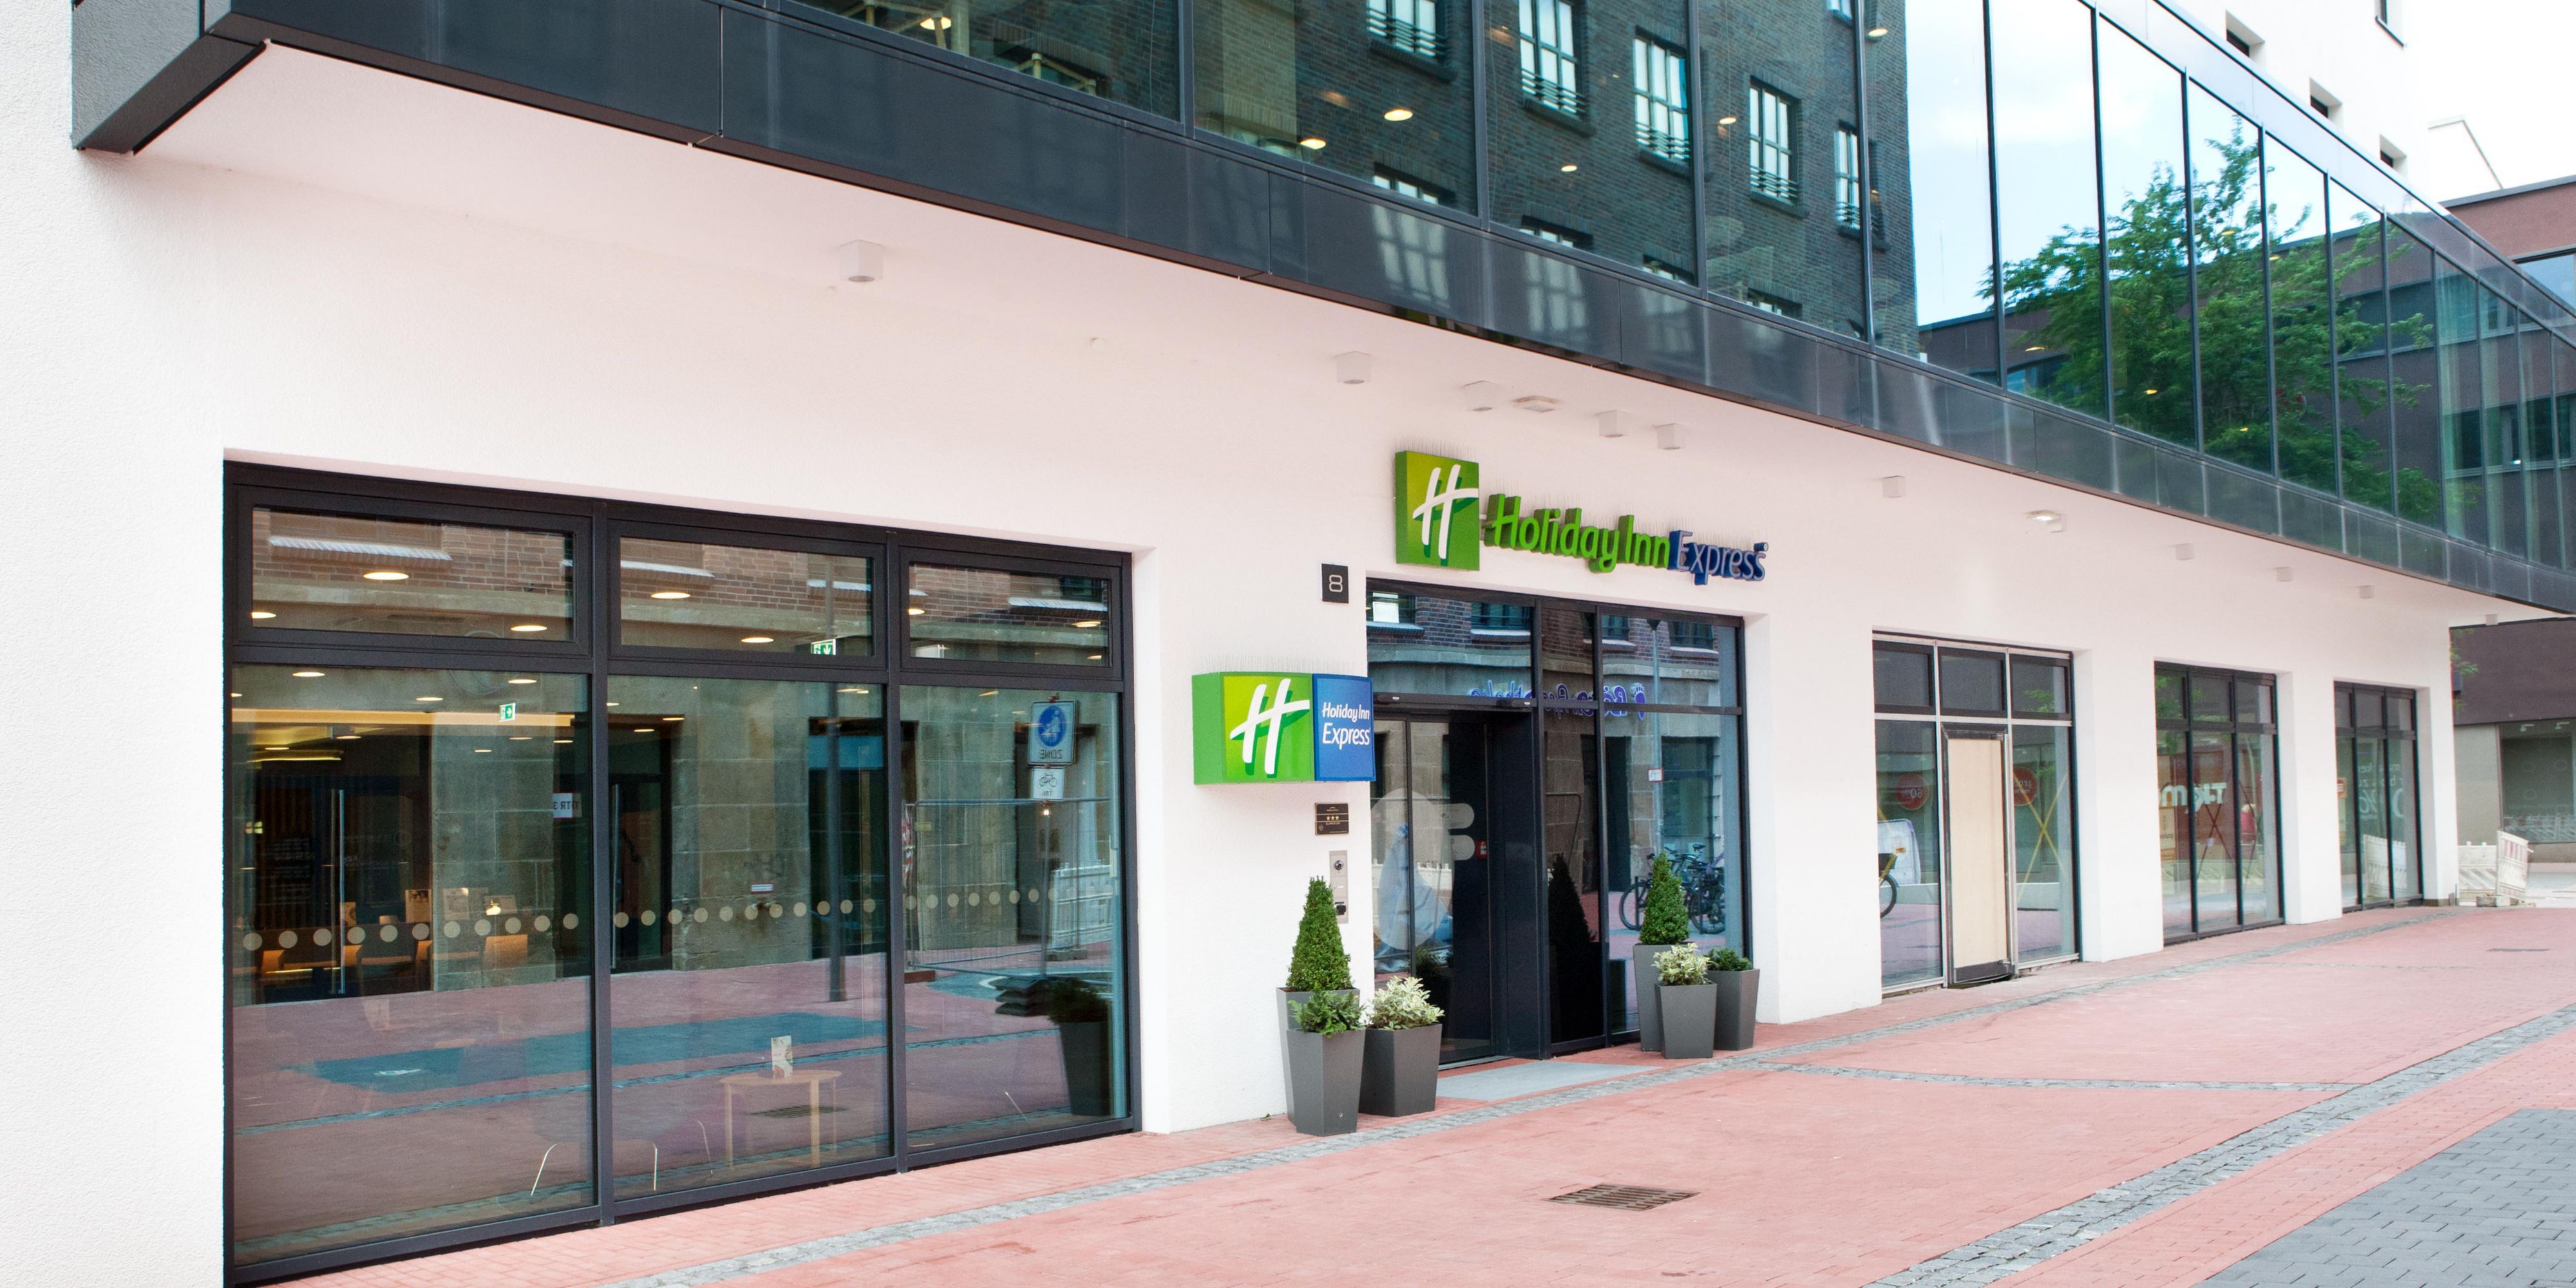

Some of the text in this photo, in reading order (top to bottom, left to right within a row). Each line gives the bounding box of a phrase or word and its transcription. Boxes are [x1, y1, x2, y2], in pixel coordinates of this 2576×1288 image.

[1413, 464, 1479, 560] H
[1489, 493, 1766, 585] Holiday Inn Express
[1329, 574, 1343, 592] 8
[1229, 678, 1311, 775] H
[1322, 702, 1370, 723] Holiday Inn
[1322, 722, 1370, 750] Express
